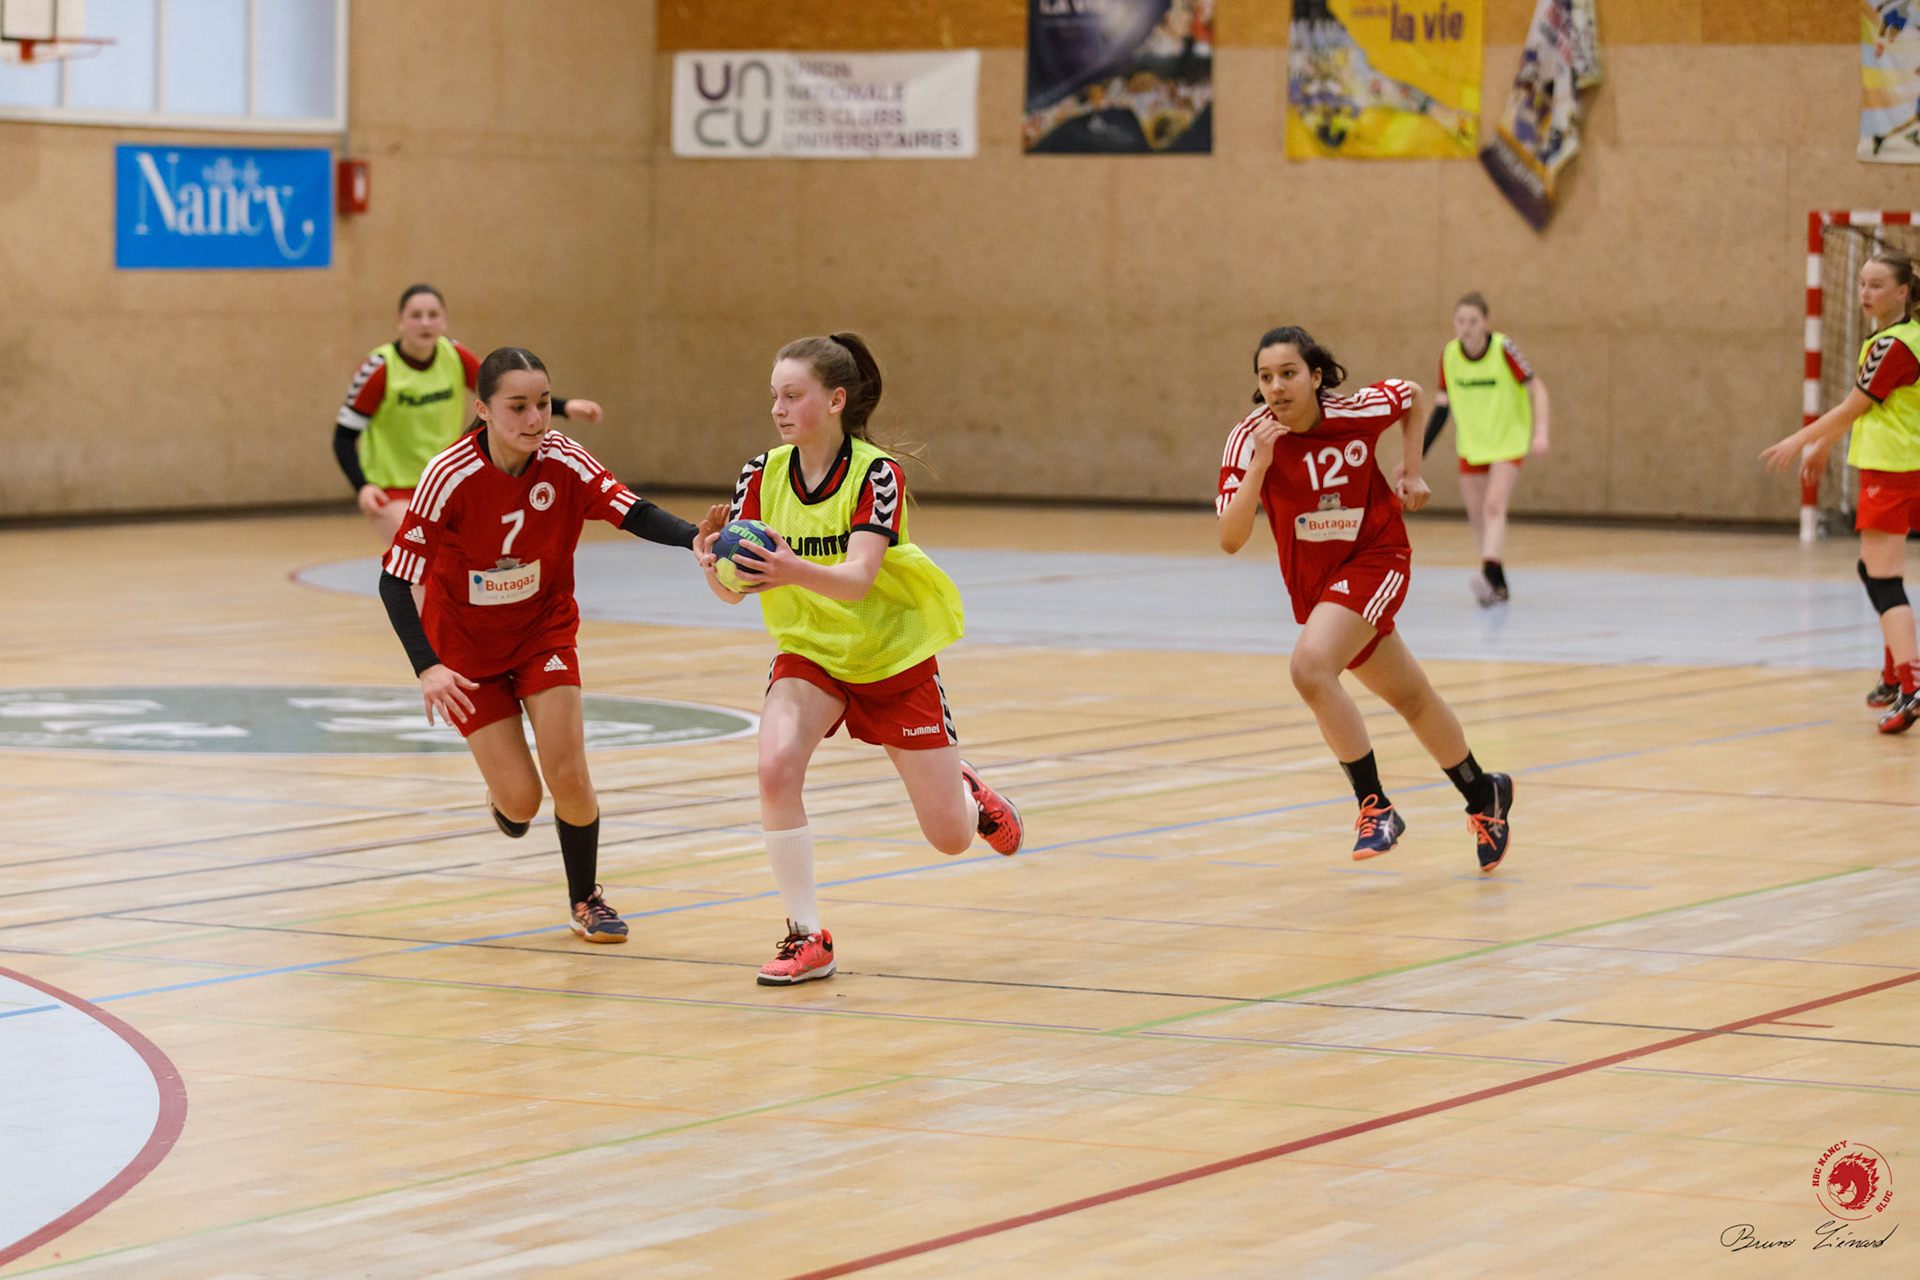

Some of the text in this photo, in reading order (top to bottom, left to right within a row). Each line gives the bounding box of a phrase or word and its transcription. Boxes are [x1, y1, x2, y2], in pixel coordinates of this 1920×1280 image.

[1392, 1, 1463, 42] la vie
[134, 152, 315, 260] Nancy
[1303, 447, 1349, 491] 12
[501, 509, 525, 555] 7
[1308, 519, 1358, 531] Butagaz
[485, 573, 536, 592] Butagaz
[902, 723, 940, 737] hummel
